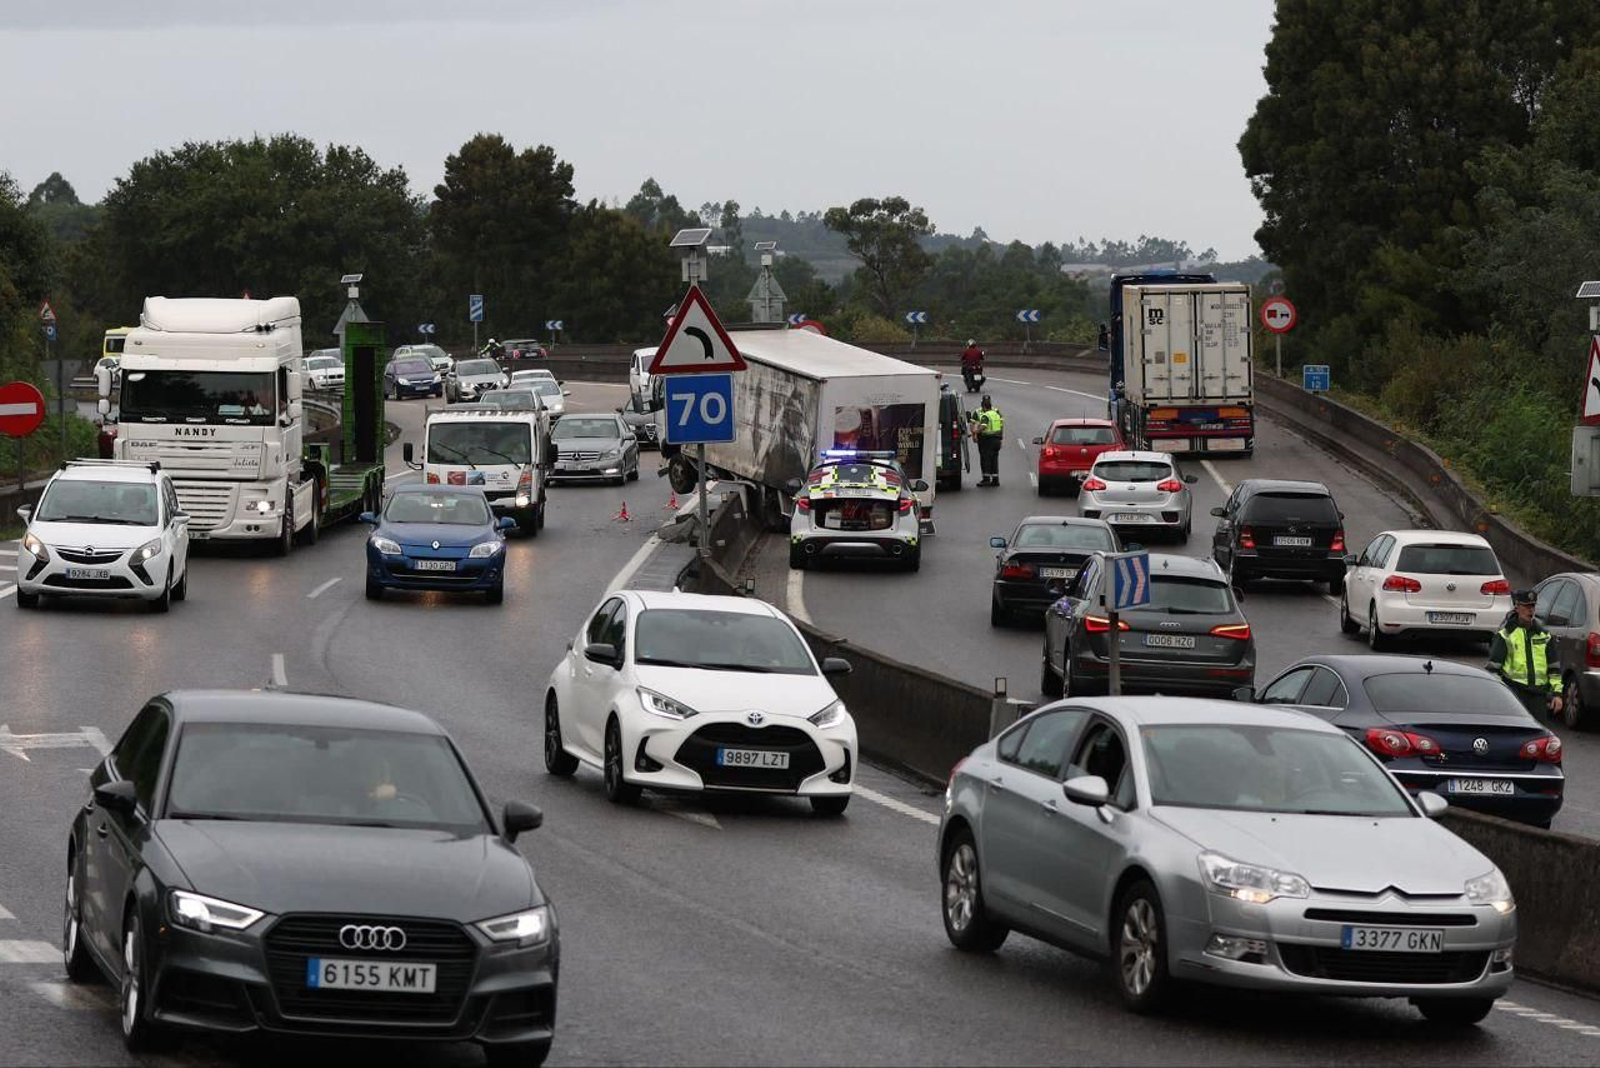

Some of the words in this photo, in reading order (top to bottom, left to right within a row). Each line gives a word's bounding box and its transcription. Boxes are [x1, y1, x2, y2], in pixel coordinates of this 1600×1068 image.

[672, 392, 727, 426] 70
[175, 428, 217, 437] NANDY
[71, 569, 91, 578] 9284
[95, 570, 109, 579] JXB
[1149, 635, 1172, 645] 0006
[726, 751, 760, 765] 9897
[763, 753, 786, 766] LZT
[1458, 780, 1485, 791] 1248
[1491, 780, 1512, 793] GKZ
[1356, 929, 1402, 949] 3377
[1407, 931, 1441, 951] GKN
[324, 963, 380, 986] 6155
[389, 967, 431, 988] KMT
